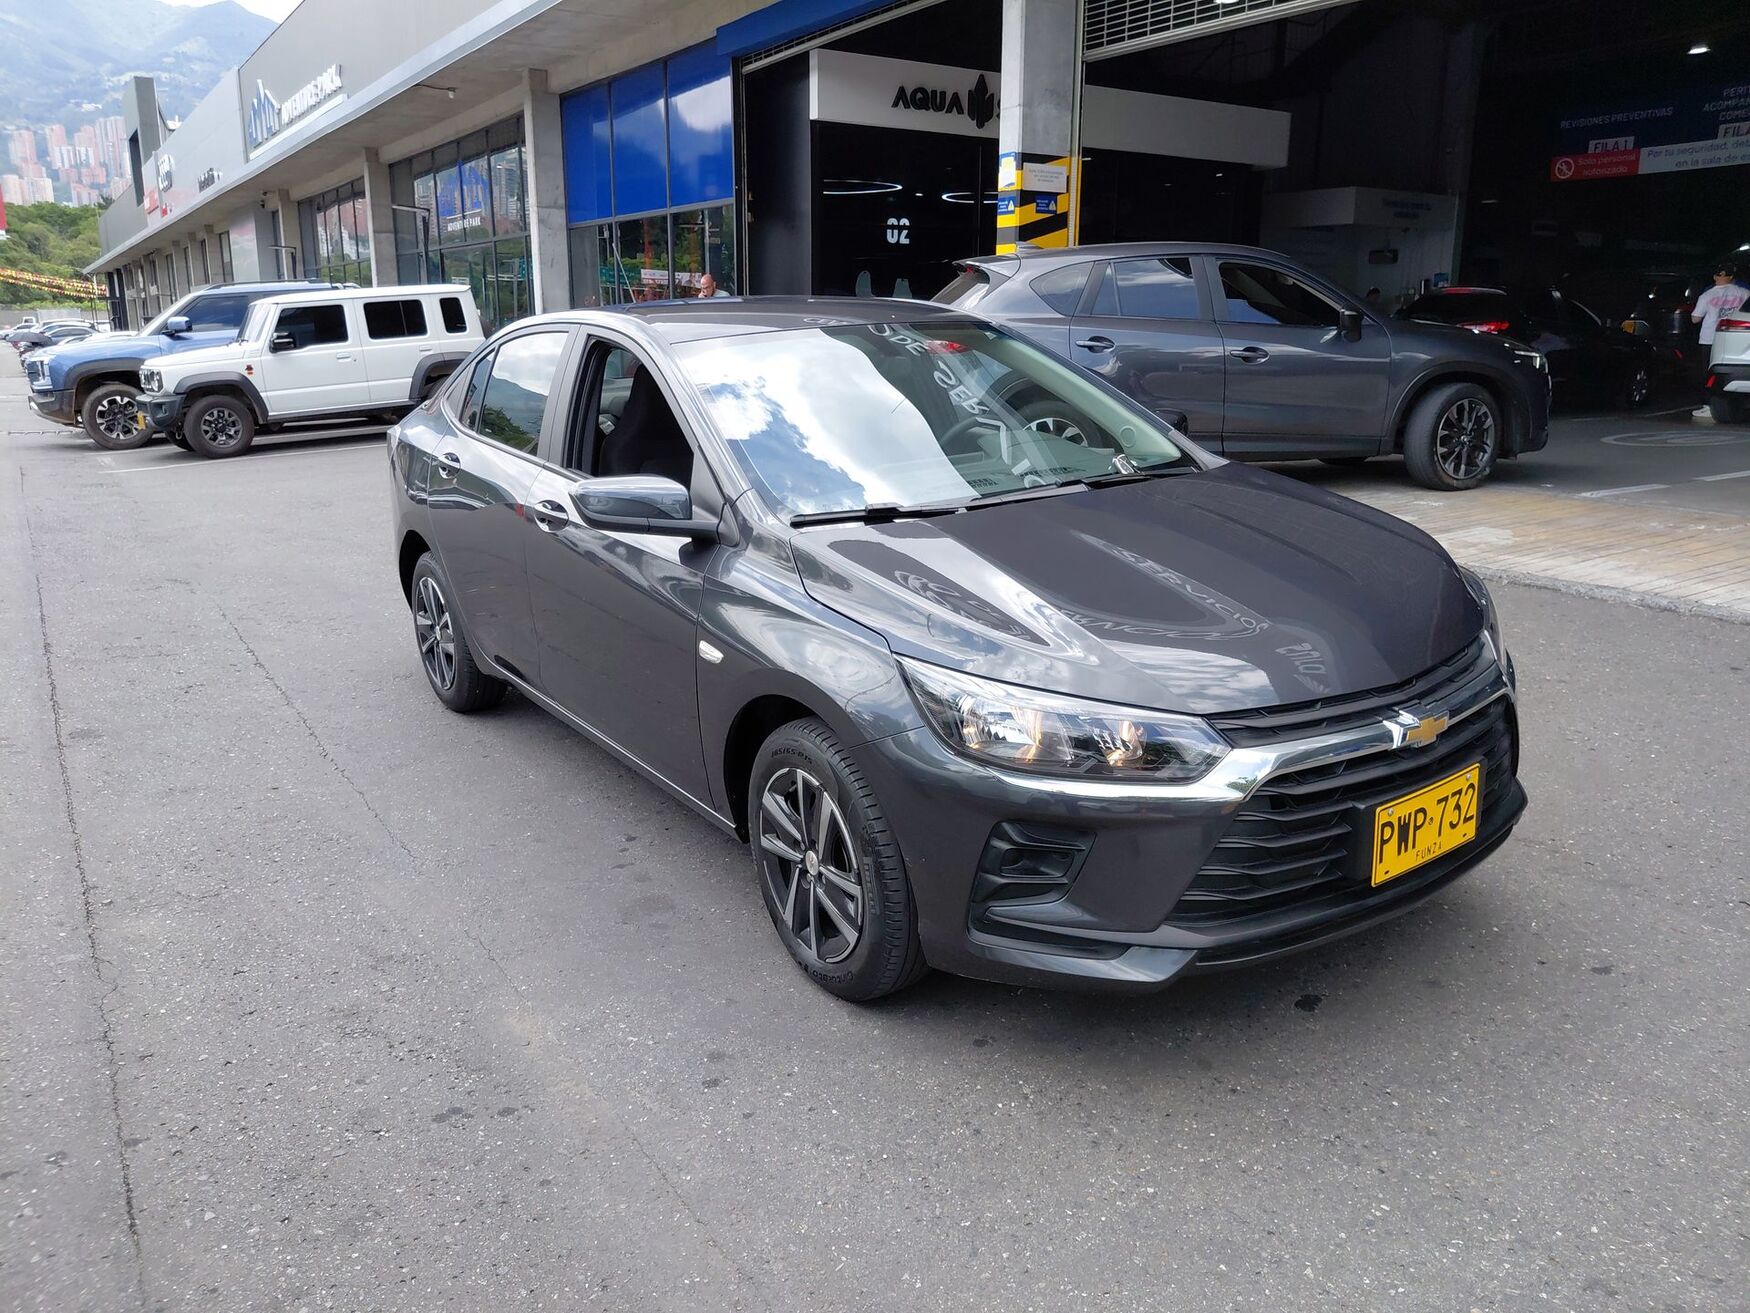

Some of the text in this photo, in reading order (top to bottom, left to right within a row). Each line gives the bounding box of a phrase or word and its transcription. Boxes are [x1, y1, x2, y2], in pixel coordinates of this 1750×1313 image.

[891, 86, 964, 115] AQUA
[1559, 106, 1674, 129] REVISIONES PREVENTIVAS
[1594, 140, 1619, 152] FILA
[887, 218, 910, 244] 02
